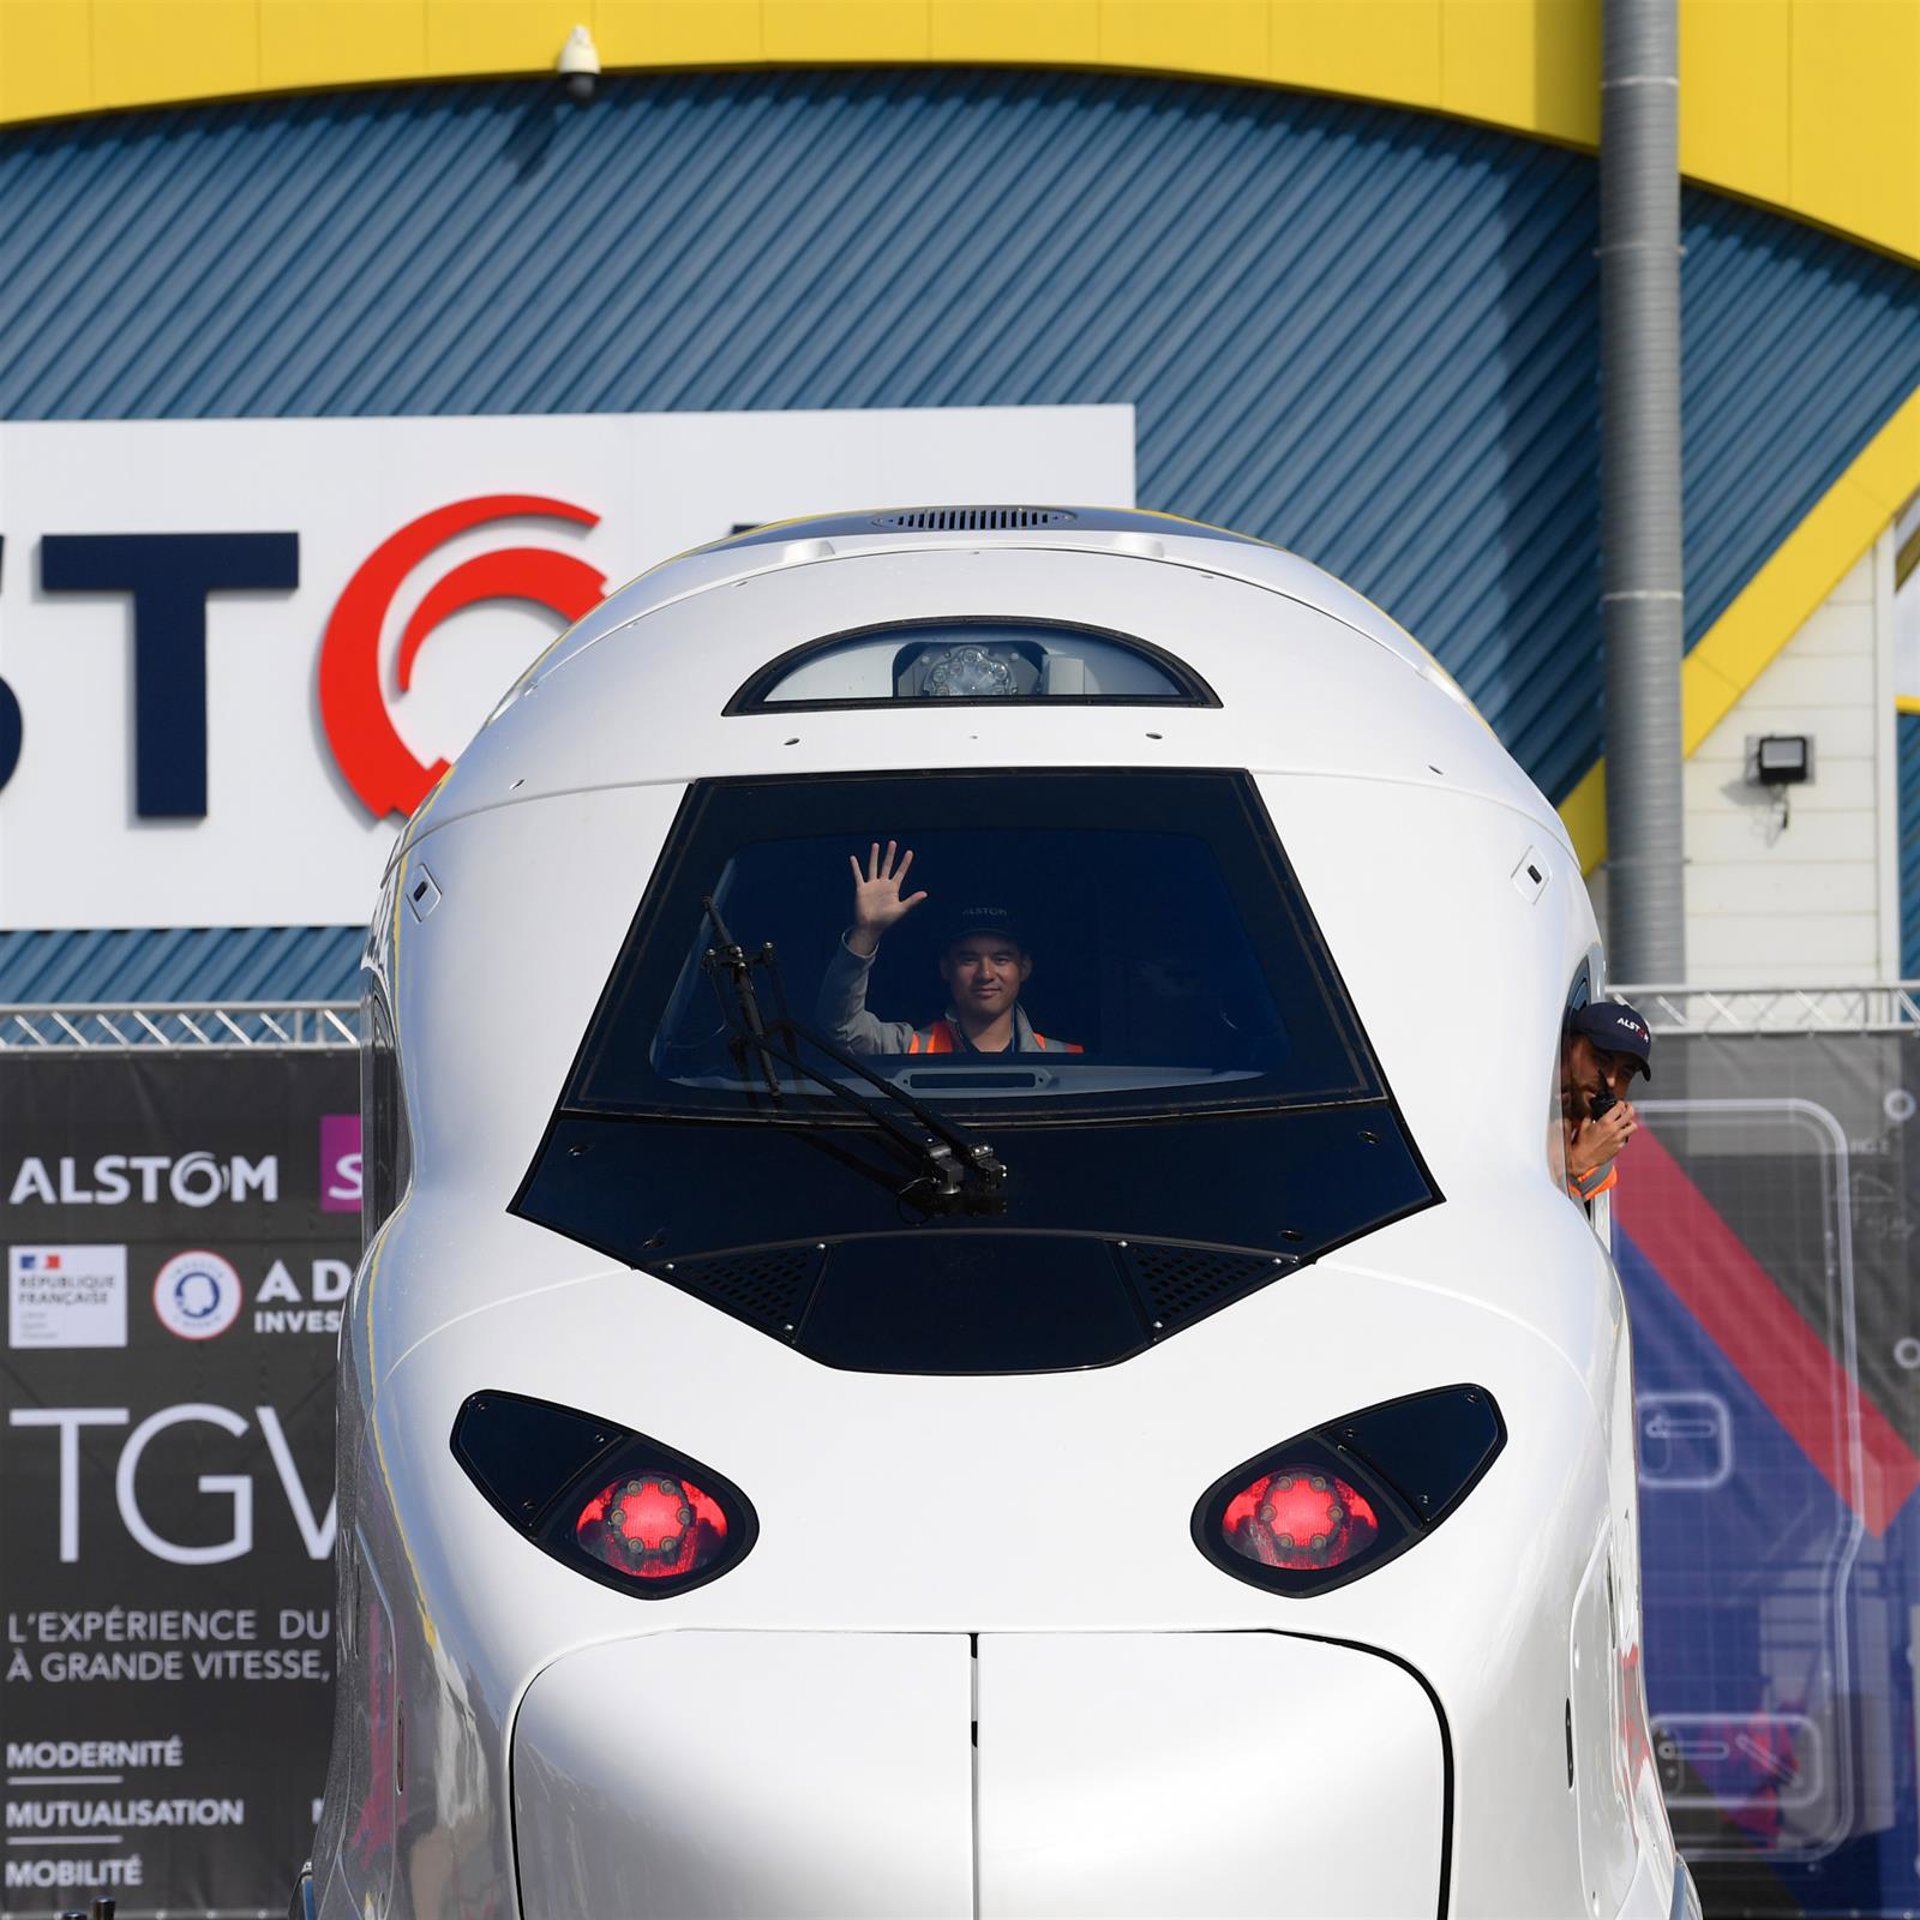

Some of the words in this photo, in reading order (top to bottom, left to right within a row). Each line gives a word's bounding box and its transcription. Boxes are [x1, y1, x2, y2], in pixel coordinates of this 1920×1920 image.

[10, 1152, 278, 1208] ALSTOM
[254, 1310, 340, 1333] INVES
[10, 1403, 337, 1565] TGV
[279, 1609, 330, 1640] DU
[6, 1648, 33, 1682] À
[40, 1652, 183, 1682] GRANDE
[191, 1650, 330, 1683] VITESSE,
[6, 1735, 183, 1769] MODERNITÉ
[5, 1799, 244, 1829] MUTUALISATION
[4, 1853, 143, 1888] MOBILITÉ
